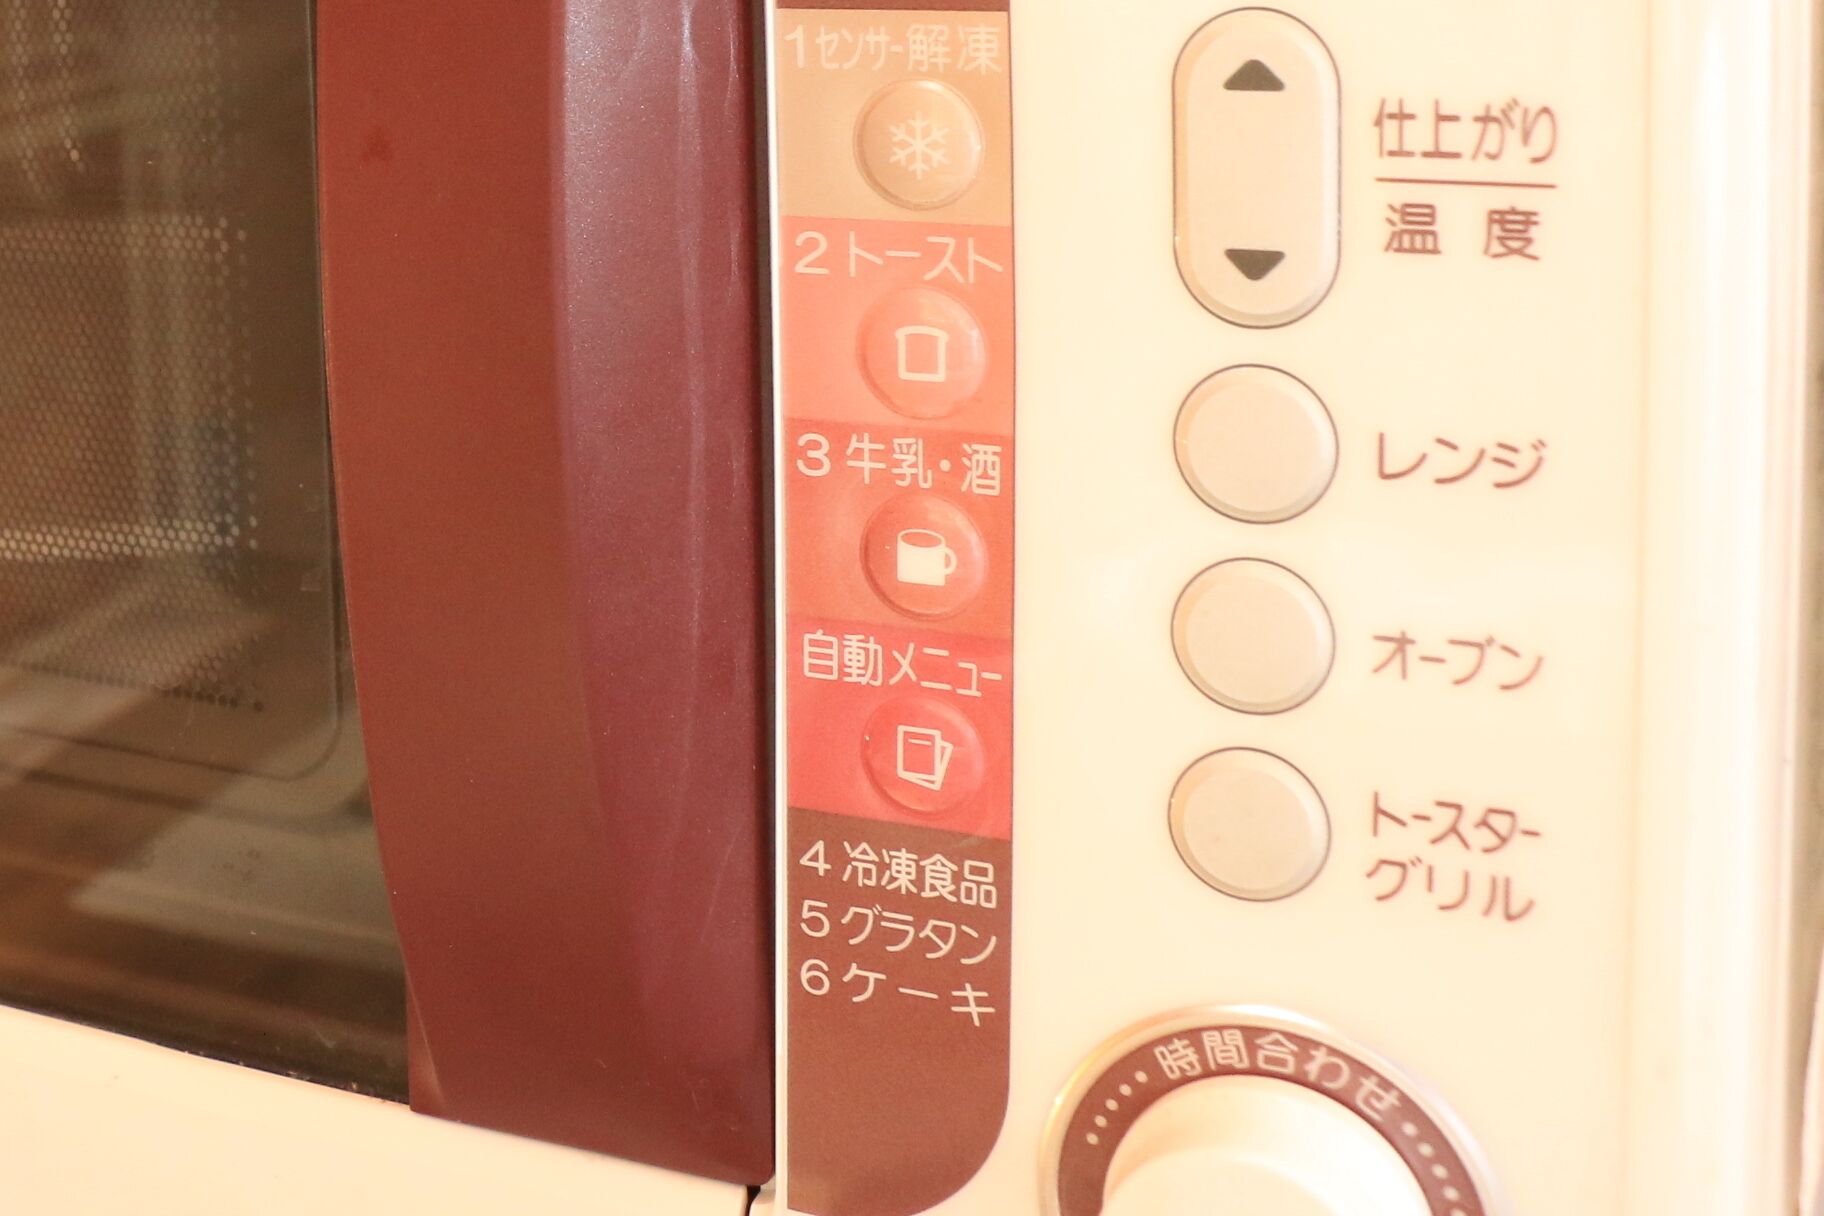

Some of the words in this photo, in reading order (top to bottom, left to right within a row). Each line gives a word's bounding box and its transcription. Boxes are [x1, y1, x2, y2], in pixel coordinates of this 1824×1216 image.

[815, 23, 1003, 74] センサー解凍
[1373, 97, 1558, 164] 仕上がり
[794, 230, 831, 275] 2
[848, 230, 1004, 284] トースト
[1384, 202, 1540, 261] 温度
[795, 432, 832, 477] 3
[845, 432, 1003, 497] 牛乳・酒
[1378, 432, 1546, 489] レンジ
[803, 628, 1003, 698] 自動メニュー
[1372, 630, 1544, 691] オーブン
[1372, 790, 1542, 854] トースター
[799, 840, 832, 877] 4
[841, 840, 998, 909] 冷凍食品
[1365, 854, 1535, 922] グリル
[800, 899, 831, 938] 5
[840, 903, 998, 965] グラタン
[800, 958, 831, 996] 6
[841, 962, 996, 1027] ケーキ
[1153, 1028, 1401, 1122] 時間合わせ
